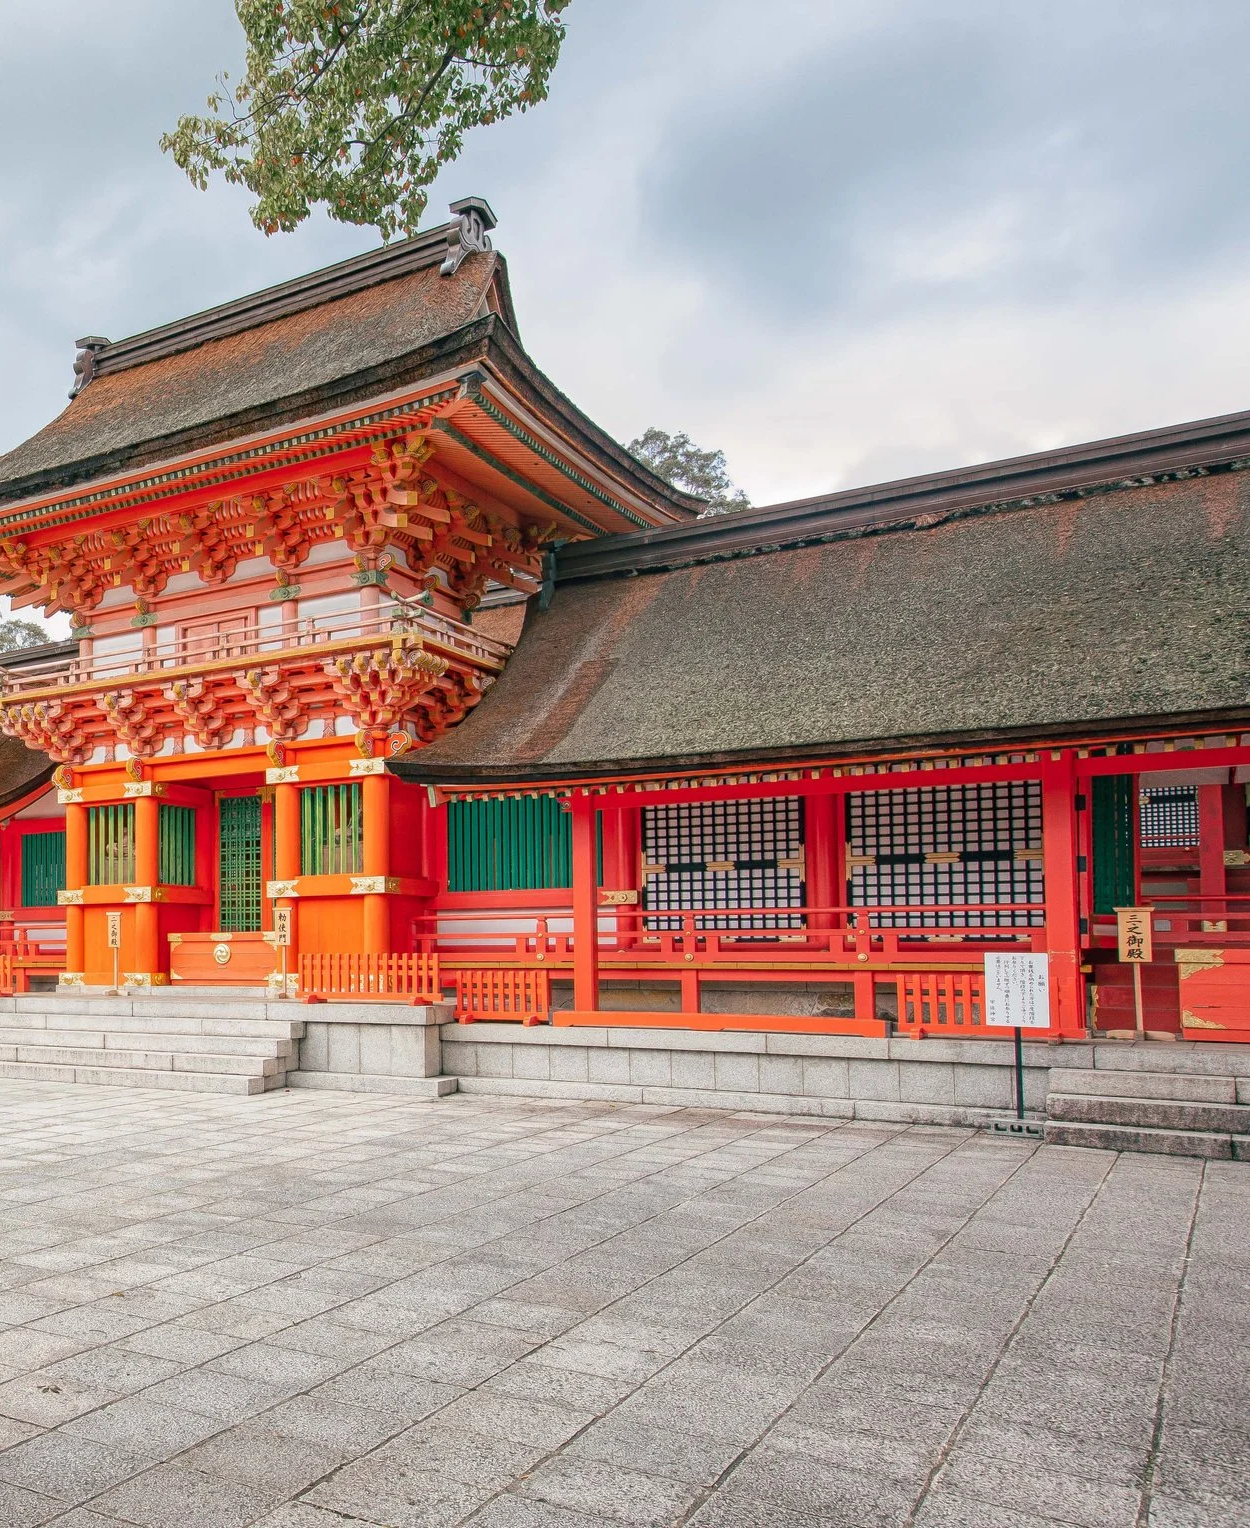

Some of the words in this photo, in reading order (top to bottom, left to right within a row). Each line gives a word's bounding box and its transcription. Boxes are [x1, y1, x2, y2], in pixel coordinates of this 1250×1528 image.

[278, 912, 287, 943] 勅使門
[1126, 914, 1145, 960] 三之御殿
